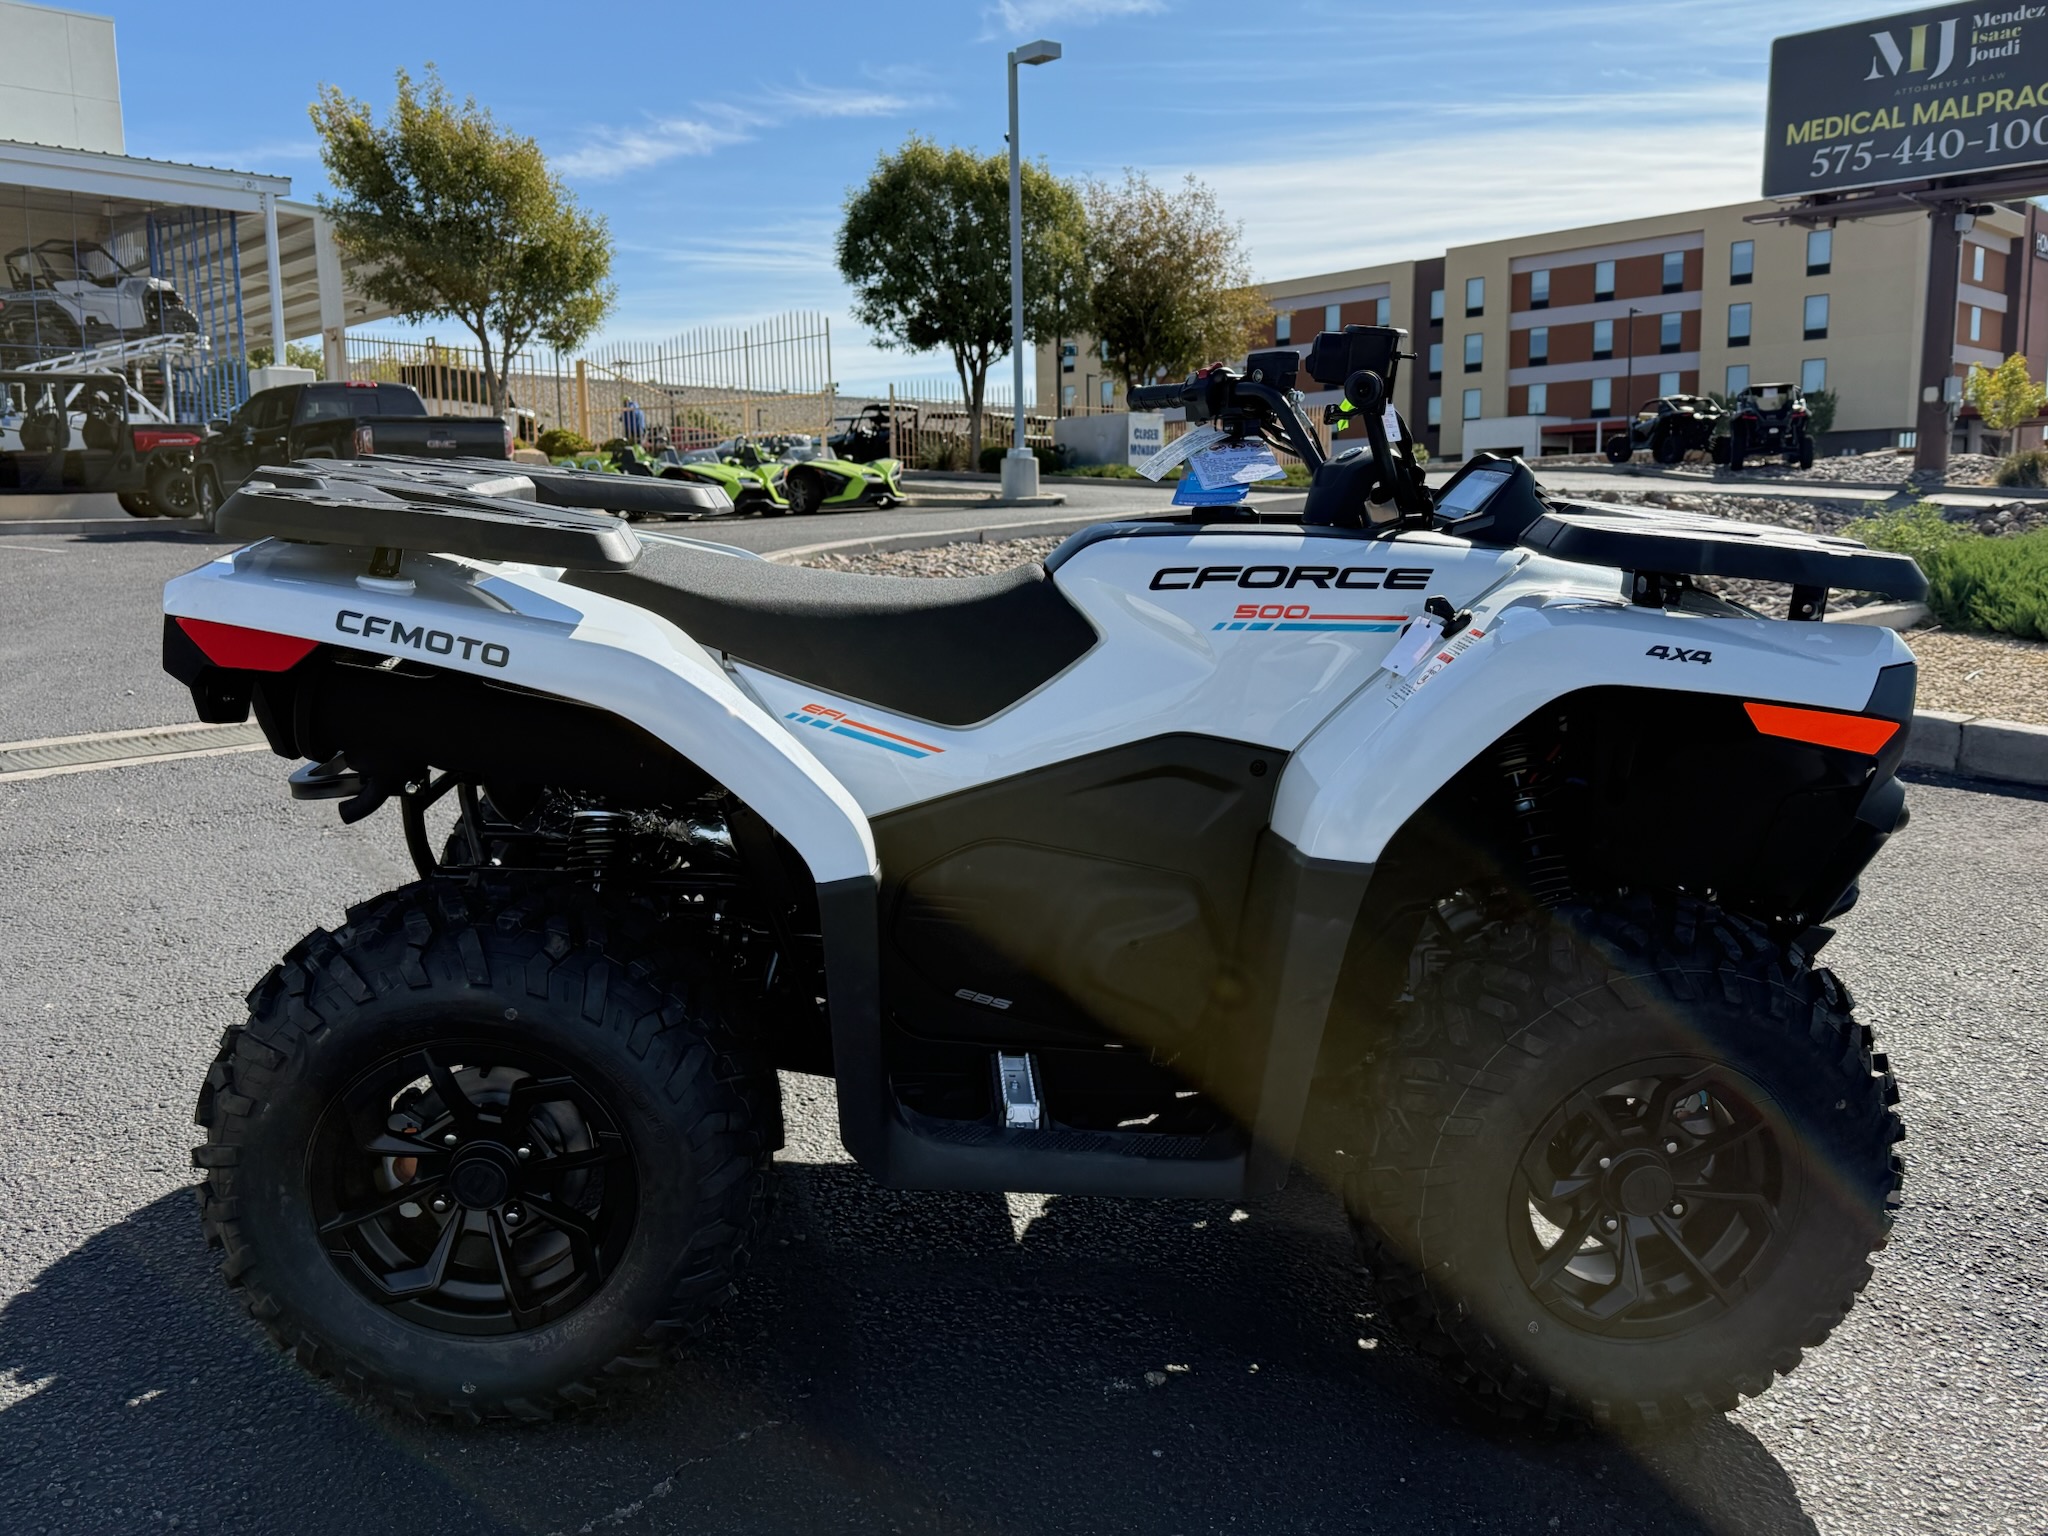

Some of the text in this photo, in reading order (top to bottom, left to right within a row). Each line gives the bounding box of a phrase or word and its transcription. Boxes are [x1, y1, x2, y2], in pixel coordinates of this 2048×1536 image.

[1972, 4, 2046, 29] Mendez
[1971, 26, 2022, 45] Isaac
[1966, 39, 2020, 68] Joudi
[1894, 71, 2007, 96] ATTORNEYS AT LAW
[1786, 105, 1906, 146] MEDICAL
[427, 440, 457, 448] GMC
[1149, 565, 1434, 591] CFORCE
[1233, 604, 1310, 619] 500
[336, 609, 510, 668] CFMOTO
[801, 703, 847, 720] EFI
[955, 988, 1013, 1010] EBS
